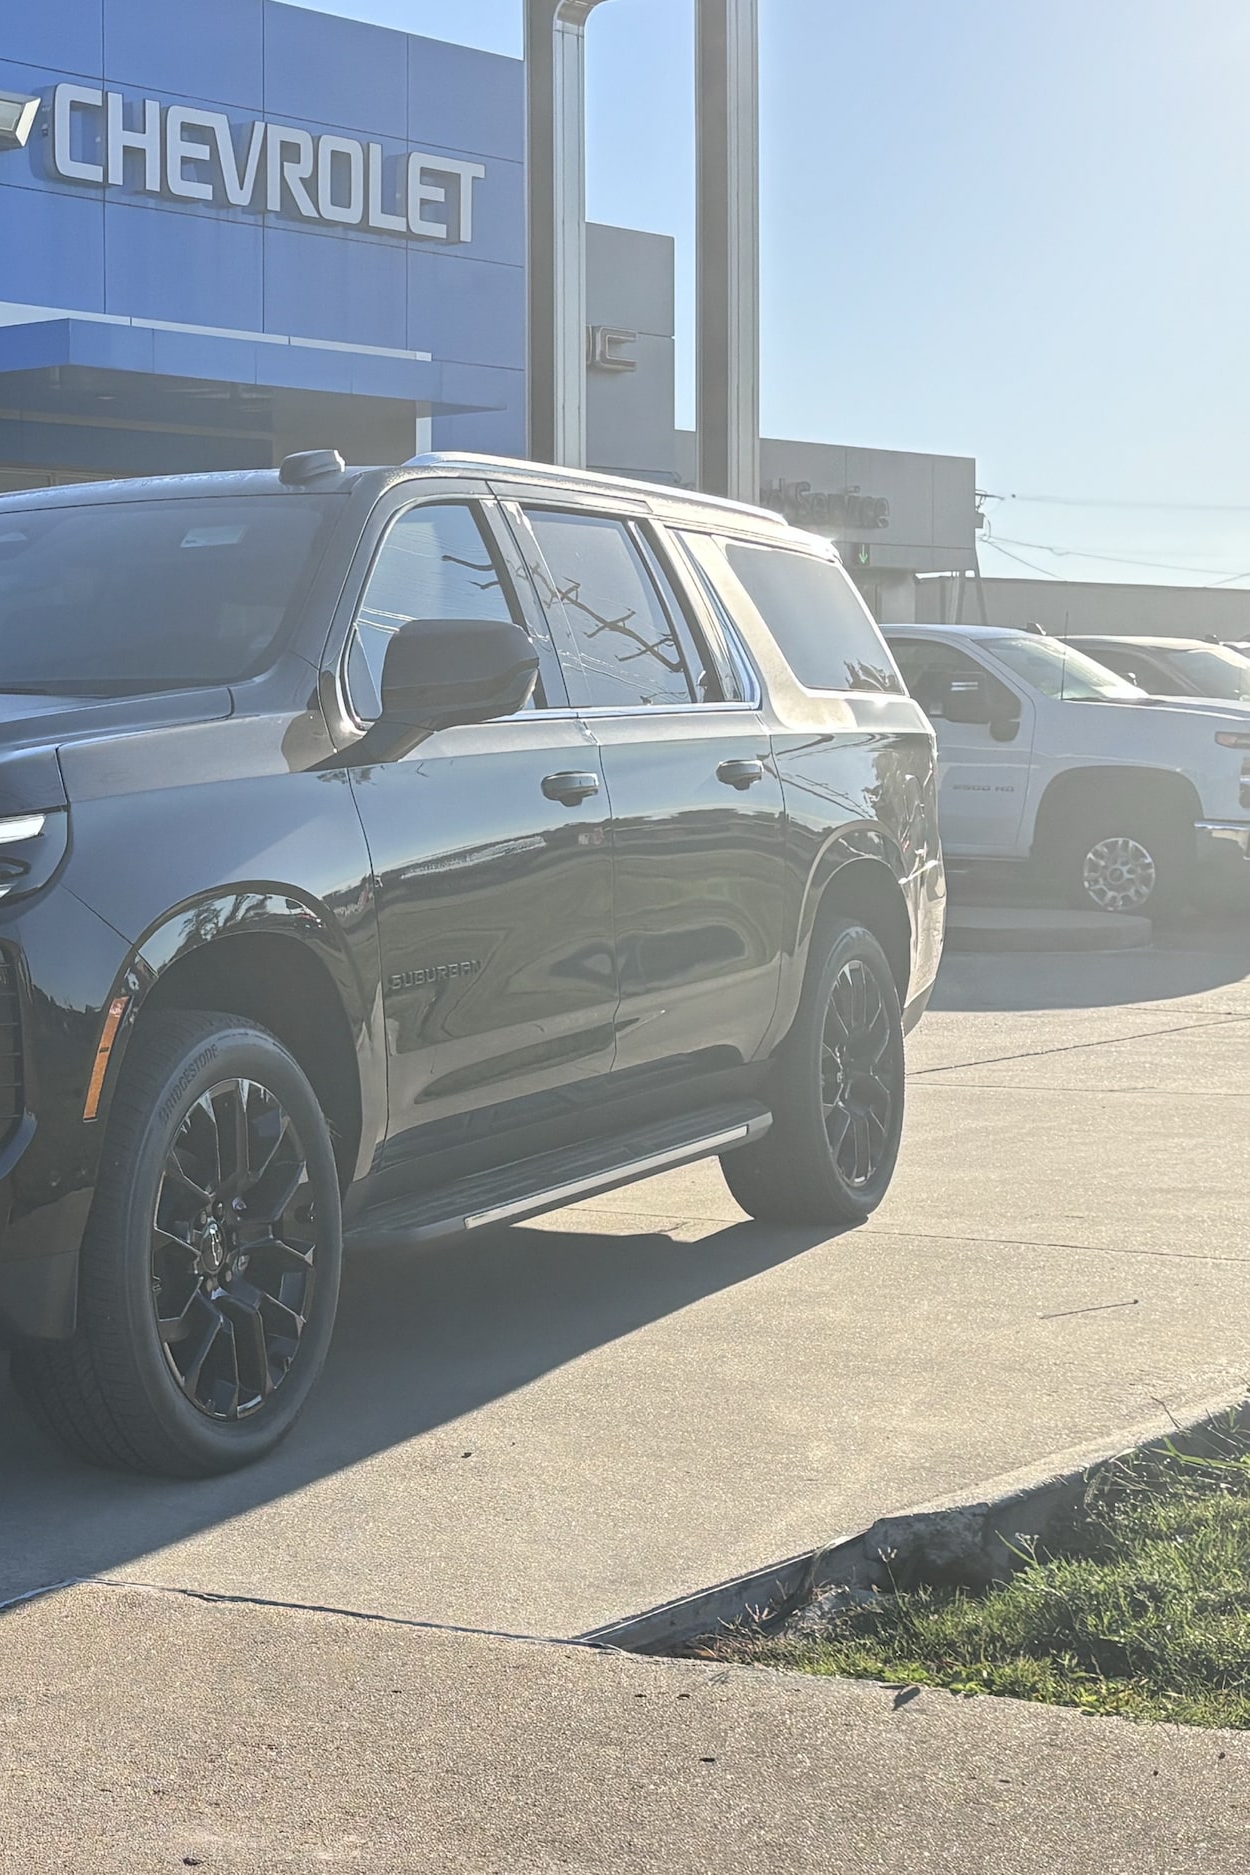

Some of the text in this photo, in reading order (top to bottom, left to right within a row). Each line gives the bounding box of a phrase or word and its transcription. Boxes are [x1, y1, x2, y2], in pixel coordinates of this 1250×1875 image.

[54, 82, 486, 243] CHEVROLET
[390, 960, 481, 990] SUBURBAN
[158, 1043, 218, 1128] BRIDGESTONE
